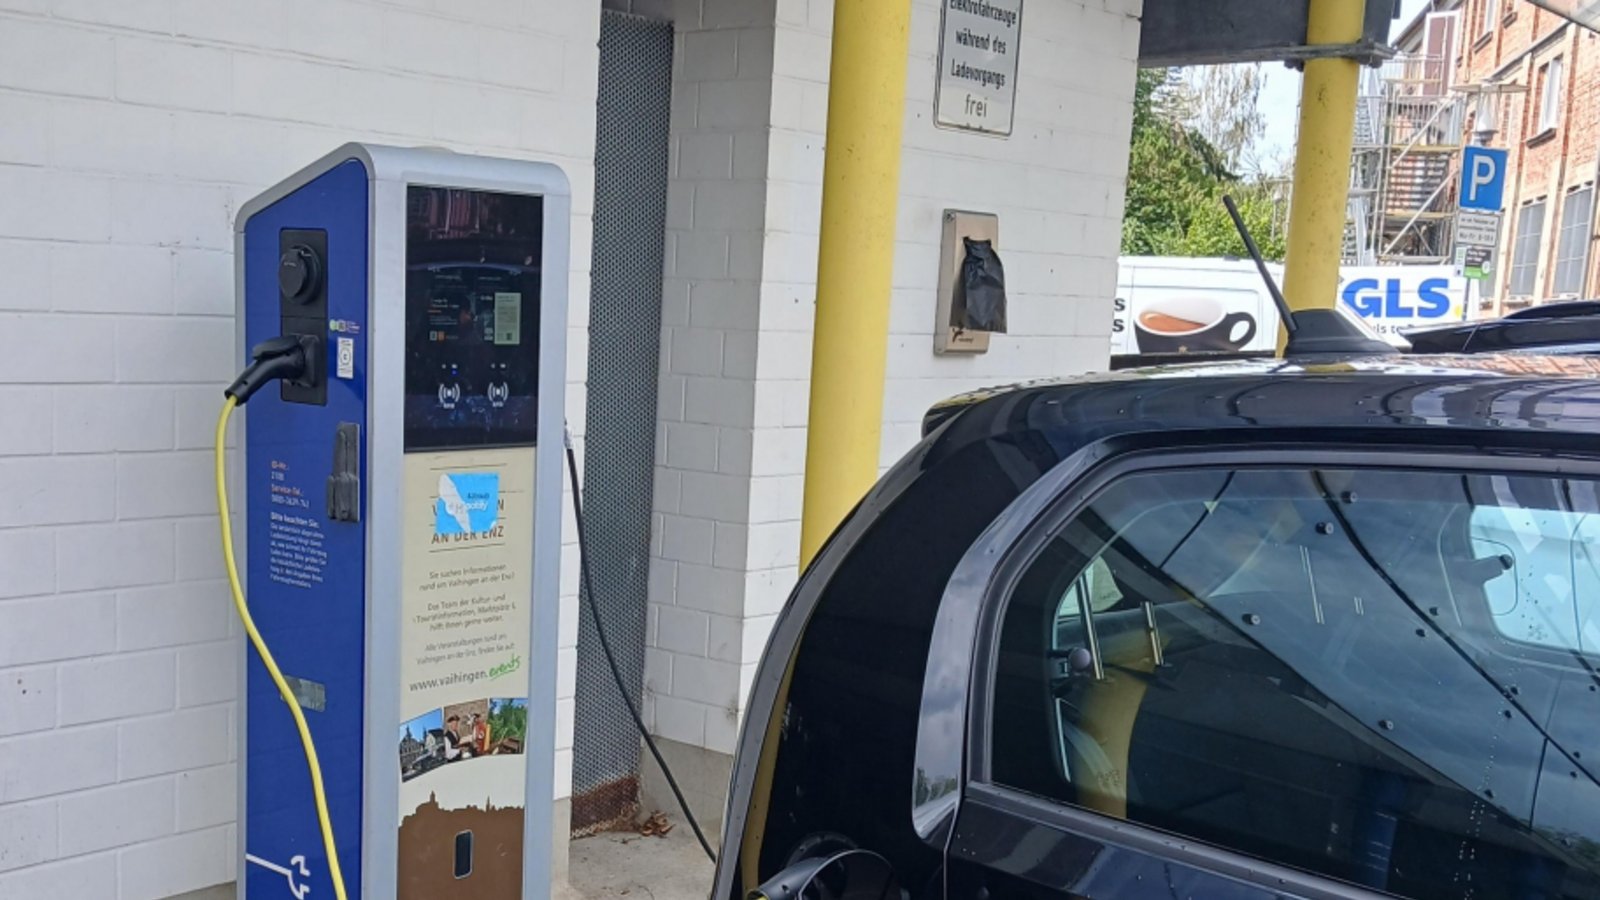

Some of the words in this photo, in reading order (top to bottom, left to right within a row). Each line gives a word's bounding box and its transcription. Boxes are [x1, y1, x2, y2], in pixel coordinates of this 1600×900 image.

[950, 0, 1016, 28] Elektrofahrzeuge
[956, 28, 990, 50] während
[992, 35, 1006, 54] des
[951, 58, 1005, 90] Ladevorgangs
[965, 93, 987, 117] frei
[1469, 155, 1495, 201] P
[1342, 278, 1450, 318] GLS
[429, 571, 439, 579] Sie
[463, 564, 506, 575] Informationen
[441, 600, 458, 609] Team
